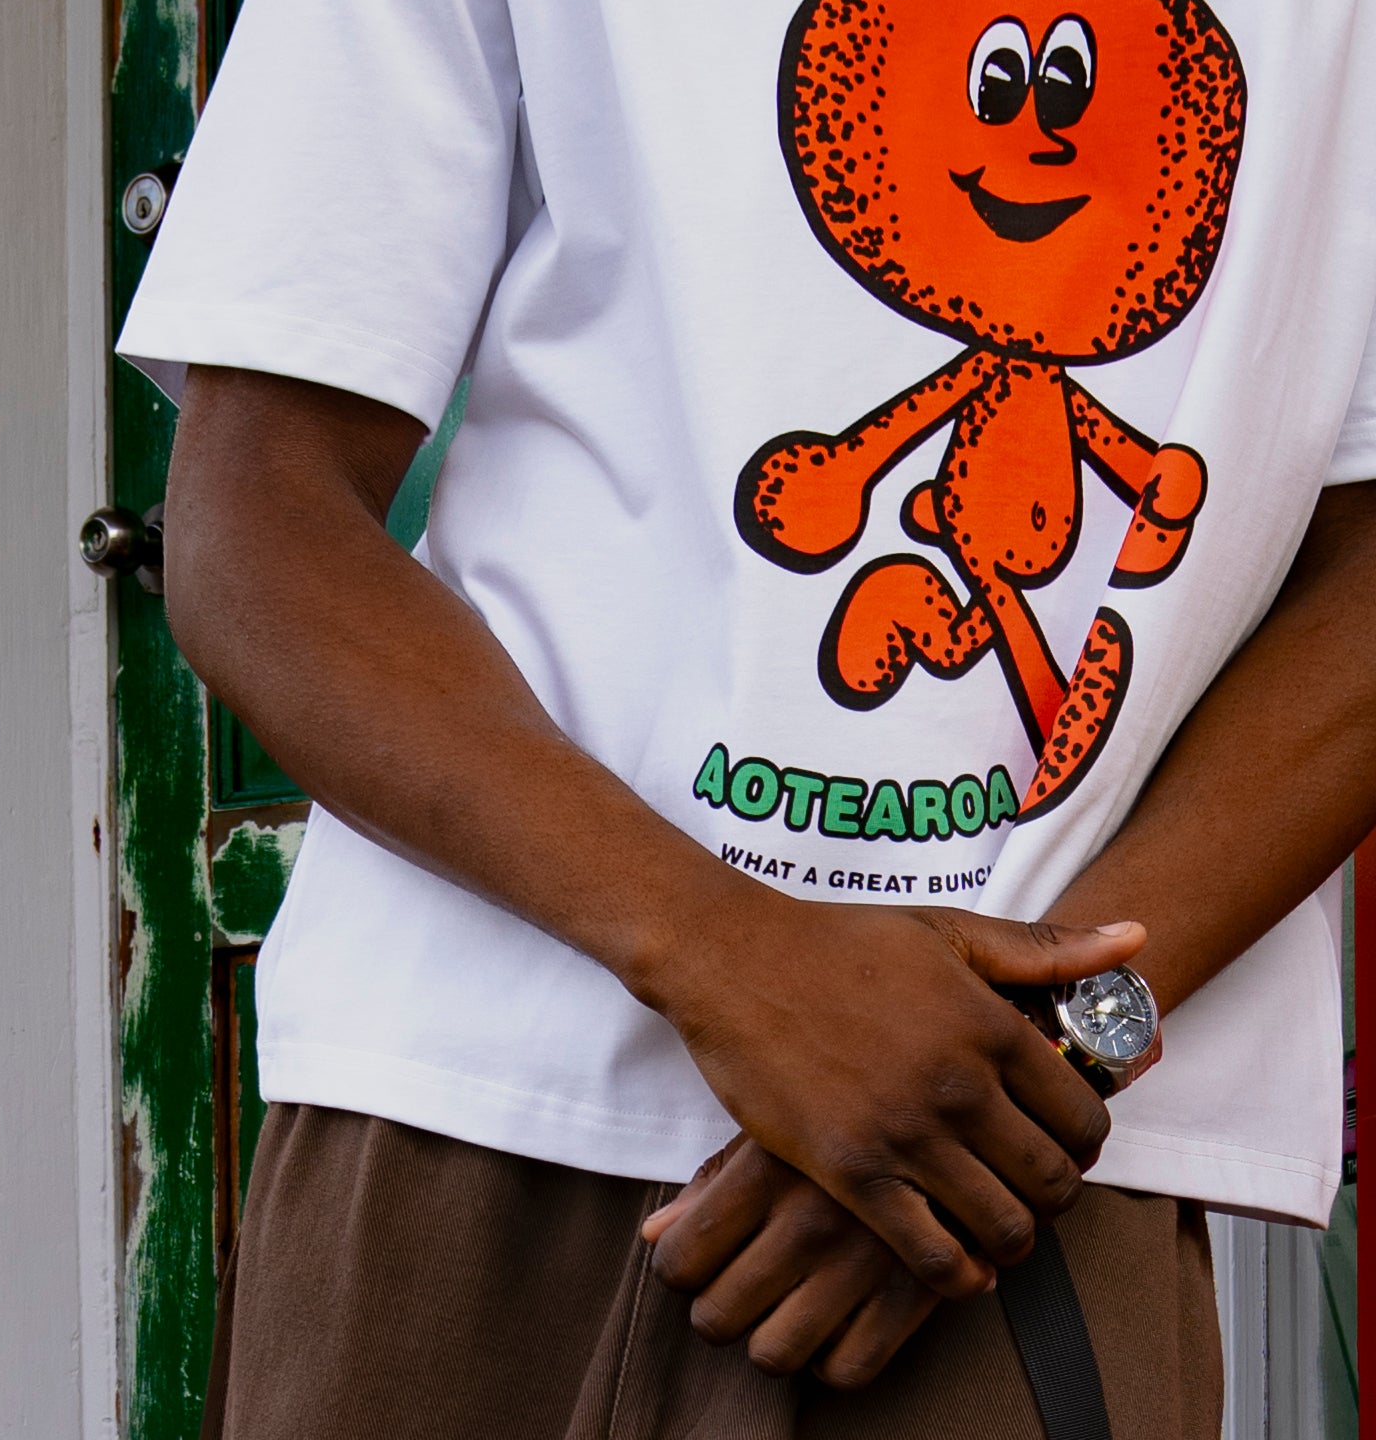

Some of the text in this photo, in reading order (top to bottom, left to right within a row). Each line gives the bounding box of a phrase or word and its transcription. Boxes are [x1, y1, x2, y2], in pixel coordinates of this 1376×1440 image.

[694, 742, 1021, 843] AOTEAROA
[721, 843, 796, 881] WHAT
[802, 866, 818, 886] A
[828, 870, 918, 894] GREAT
